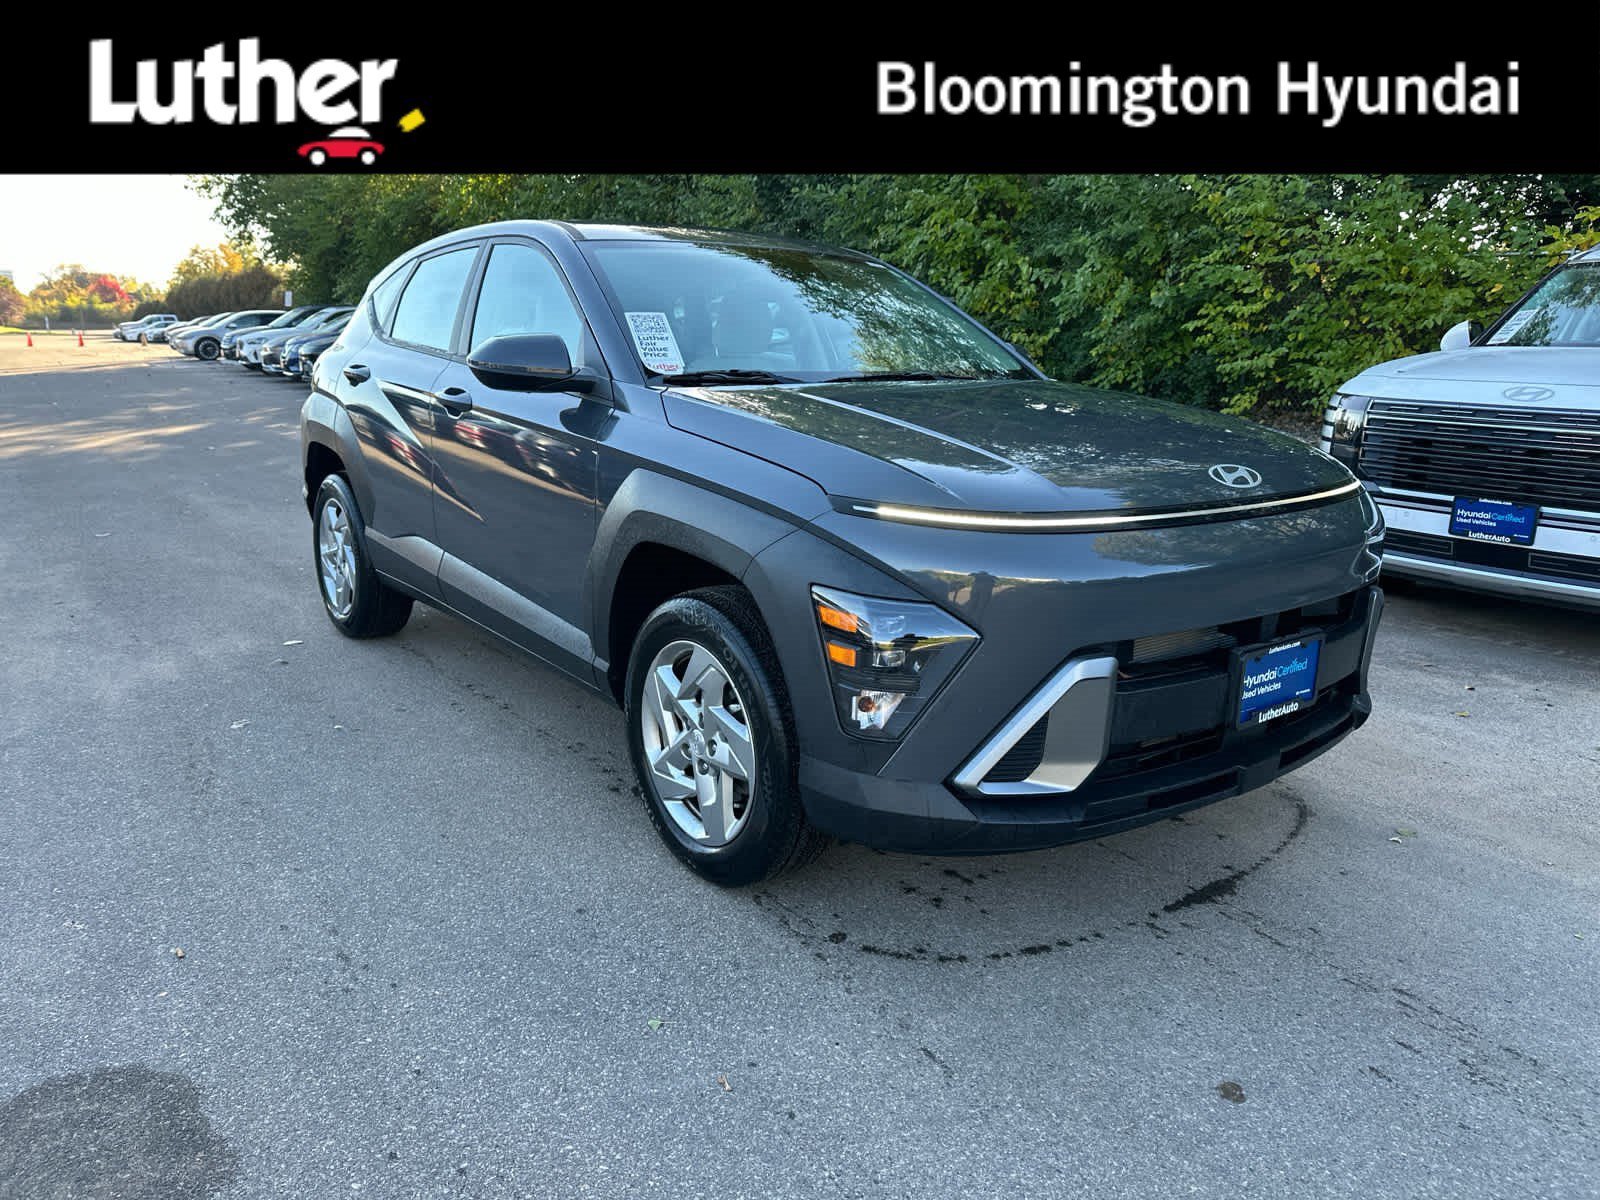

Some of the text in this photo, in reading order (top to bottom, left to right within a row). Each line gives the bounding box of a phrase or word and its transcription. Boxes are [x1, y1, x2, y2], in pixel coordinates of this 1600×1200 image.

[1457, 509, 1491, 519] Hyundai
[1472, 518, 1497, 527] Vehicles
[1468, 531, 1510, 542] LutherAuto
[1257, 682, 1281, 696] Vehicles
[1258, 702, 1299, 723] LutherAuto
